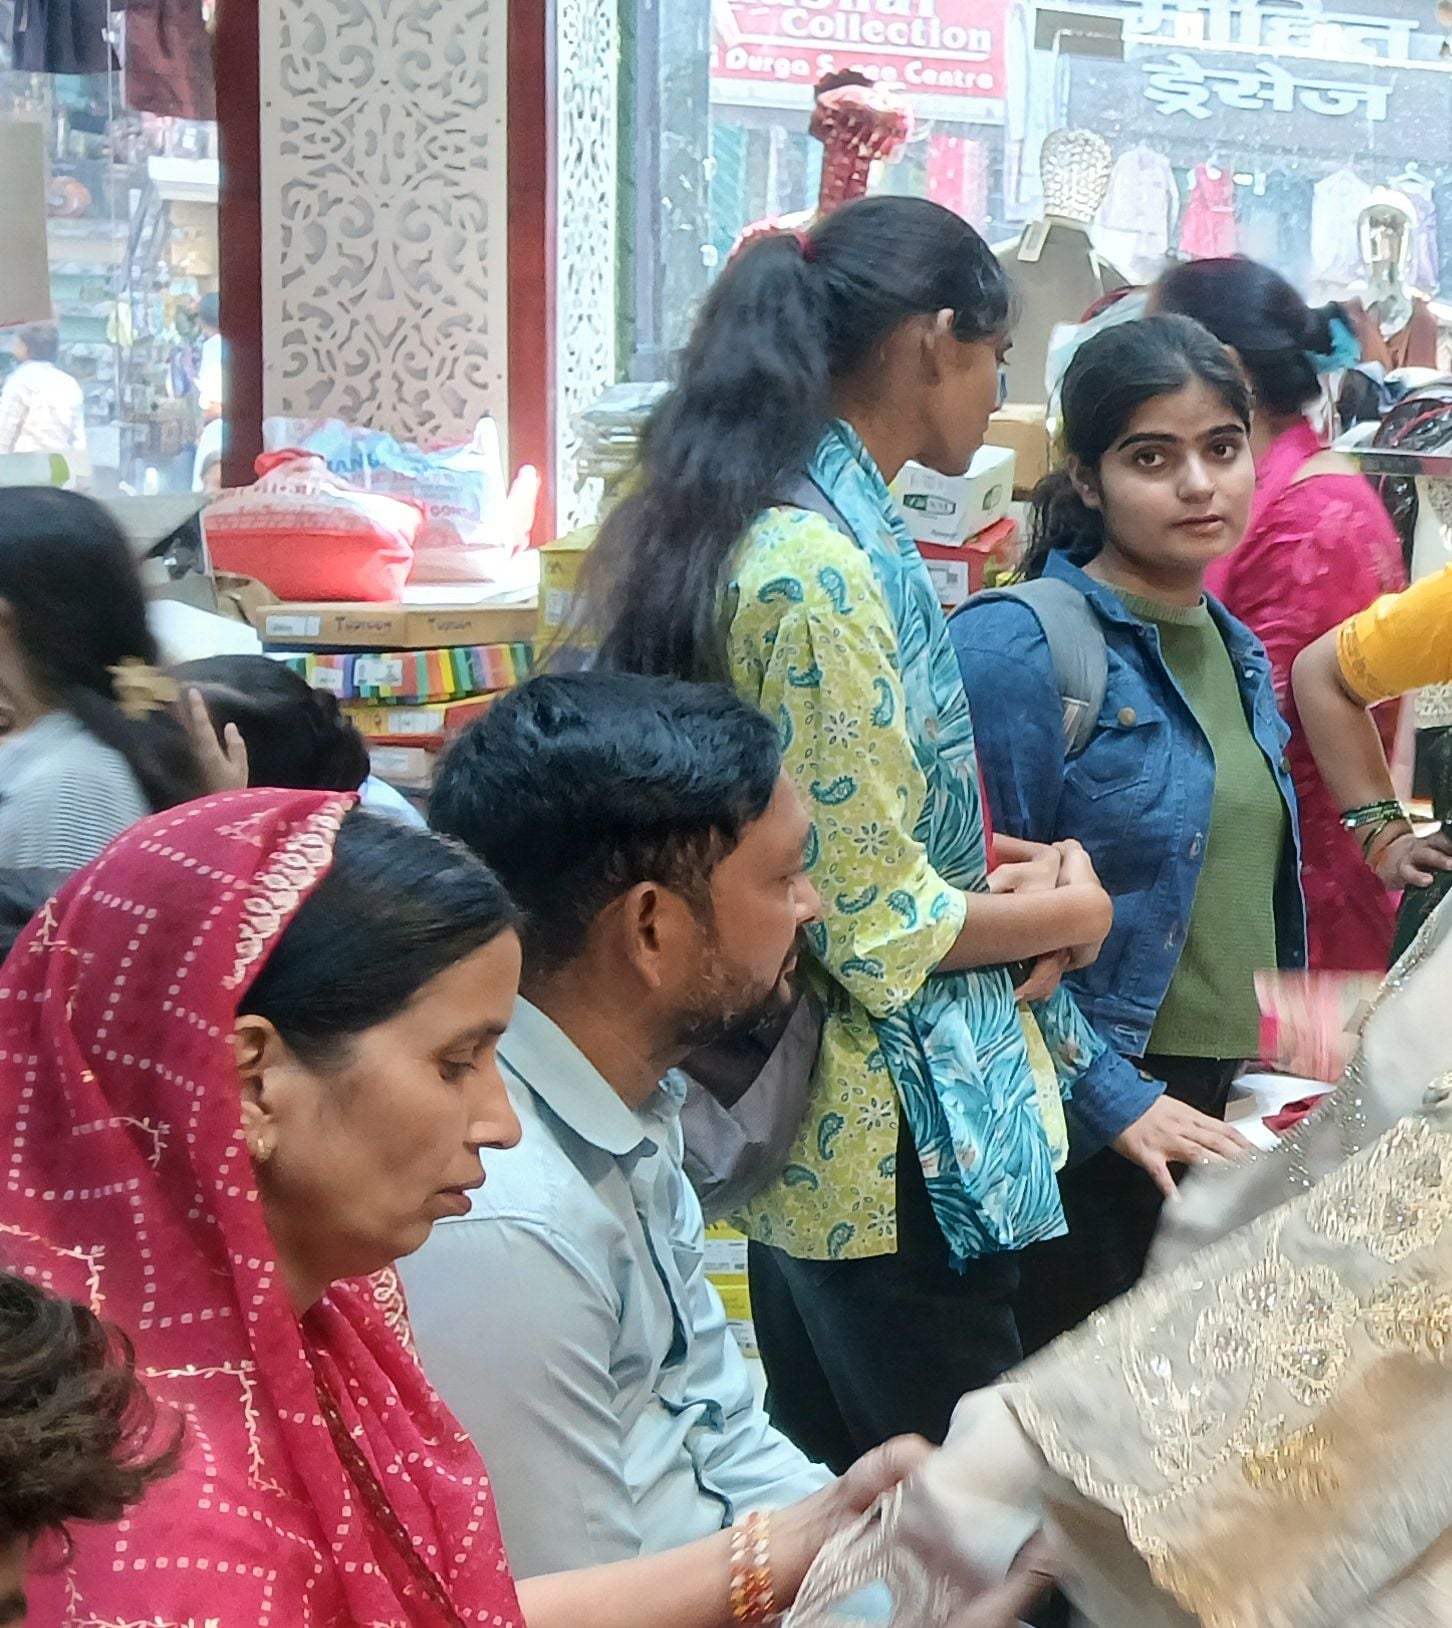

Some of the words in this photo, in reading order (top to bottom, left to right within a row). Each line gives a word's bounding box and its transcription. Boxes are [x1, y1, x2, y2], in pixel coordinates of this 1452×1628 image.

[780, 8, 992, 51] Collection
[725, 46, 811, 80] Durga
[815, 53, 898, 83] See
[903, 60, 994, 90] Centre
